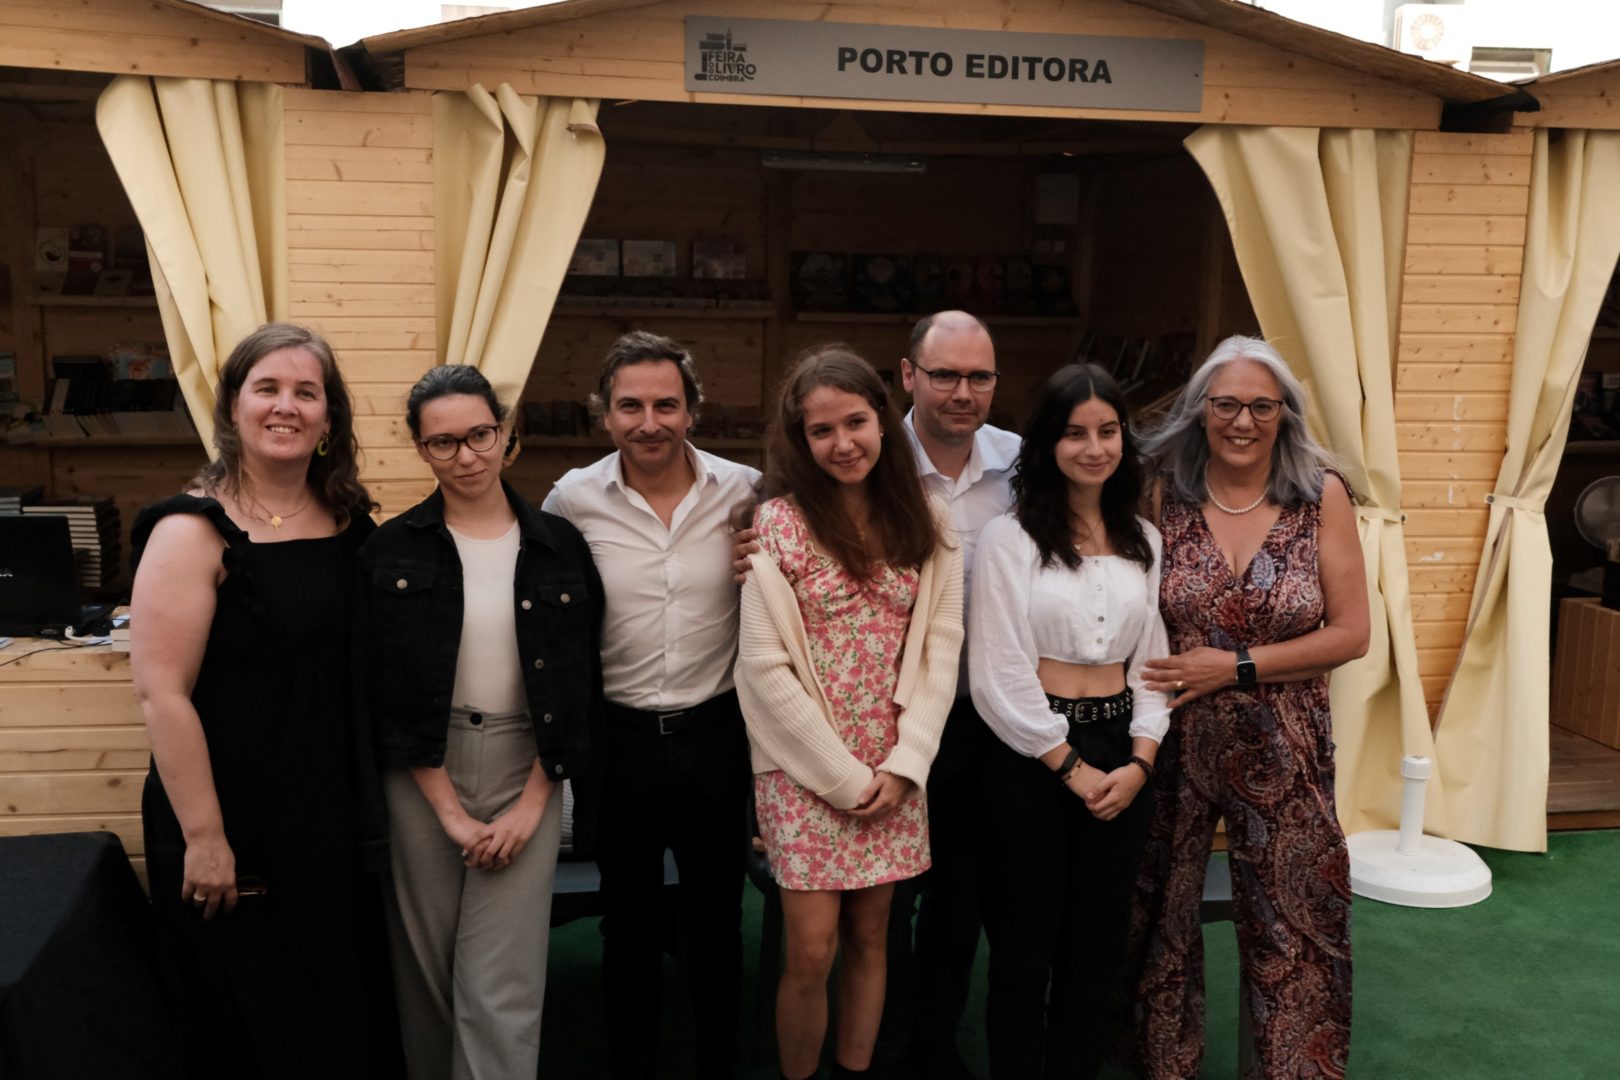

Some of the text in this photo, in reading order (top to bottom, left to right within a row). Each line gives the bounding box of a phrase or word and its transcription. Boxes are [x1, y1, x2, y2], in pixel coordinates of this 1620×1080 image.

[708, 51, 745, 63] FEIRA
[715, 62, 756, 79] LIVRO
[838, 47, 1112, 83] PORTO EDITORA
[708, 74, 745, 82] COIMBRA
